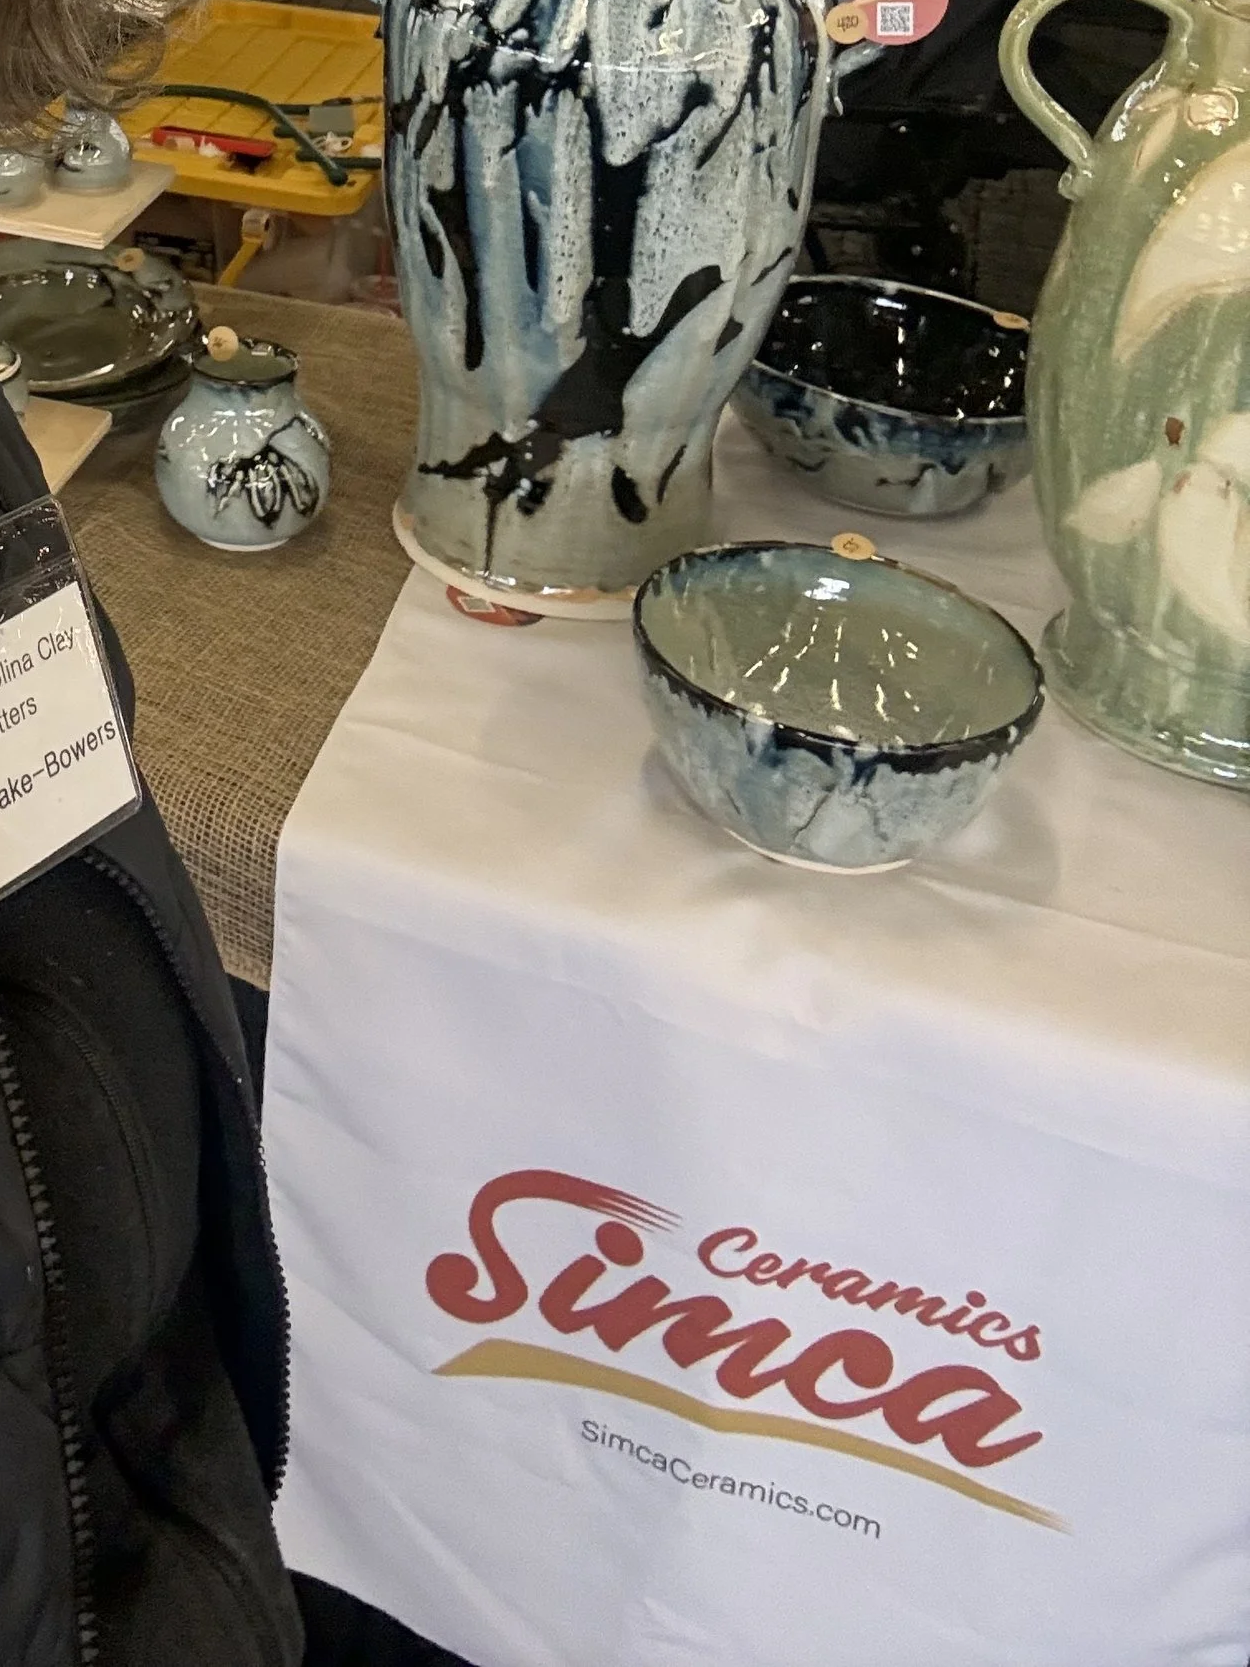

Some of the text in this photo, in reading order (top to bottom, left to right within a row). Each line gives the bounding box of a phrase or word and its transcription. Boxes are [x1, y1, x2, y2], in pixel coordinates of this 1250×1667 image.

[37, 626, 74, 661] Clay
[425, 1168, 1043, 1468] Simca
[696, 1226, 1042, 1362] Ceramics
[580, 1417, 881, 1539] SimcaCeramics.com
